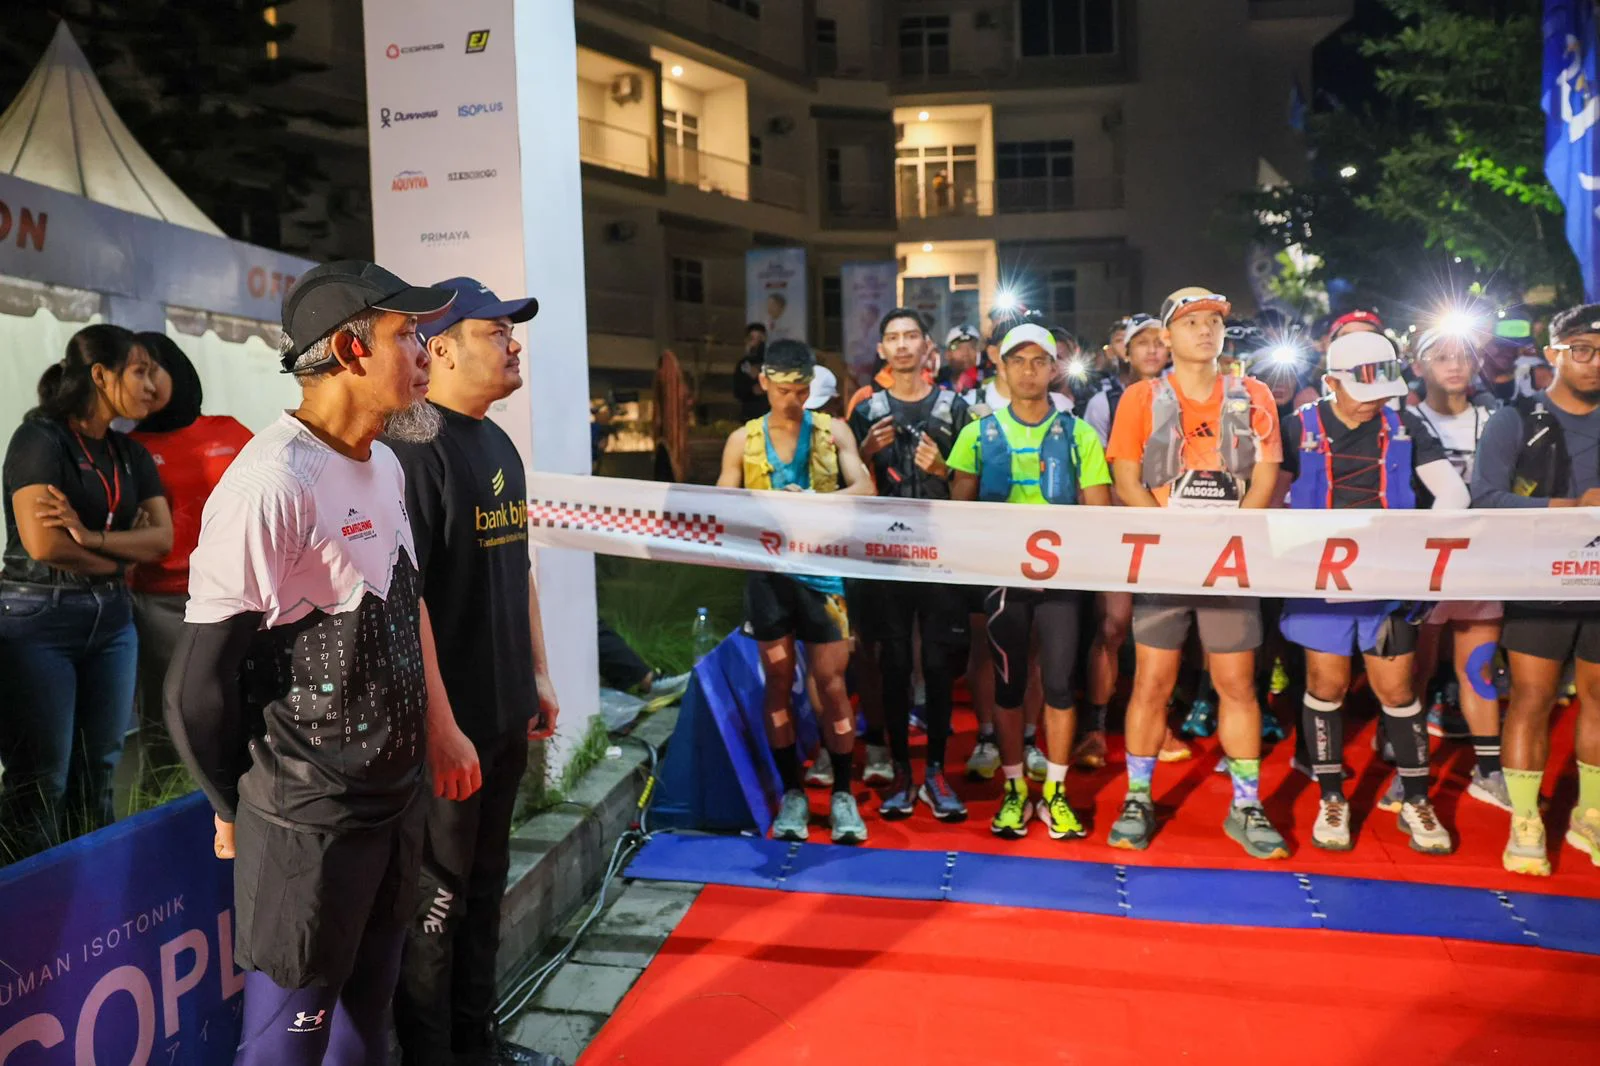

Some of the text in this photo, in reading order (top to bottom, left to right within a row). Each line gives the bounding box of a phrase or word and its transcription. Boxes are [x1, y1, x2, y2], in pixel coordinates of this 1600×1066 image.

[458, 102, 503, 117] ISOPLUS
[420, 231, 470, 243] PRIMAYA
[1183, 486, 1226, 498] M50226
[475, 503, 509, 531] bank
[789, 541, 849, 557] RELASEE
[1020, 529, 1470, 592] START
[84, 894, 184, 962] ISOTONIK
